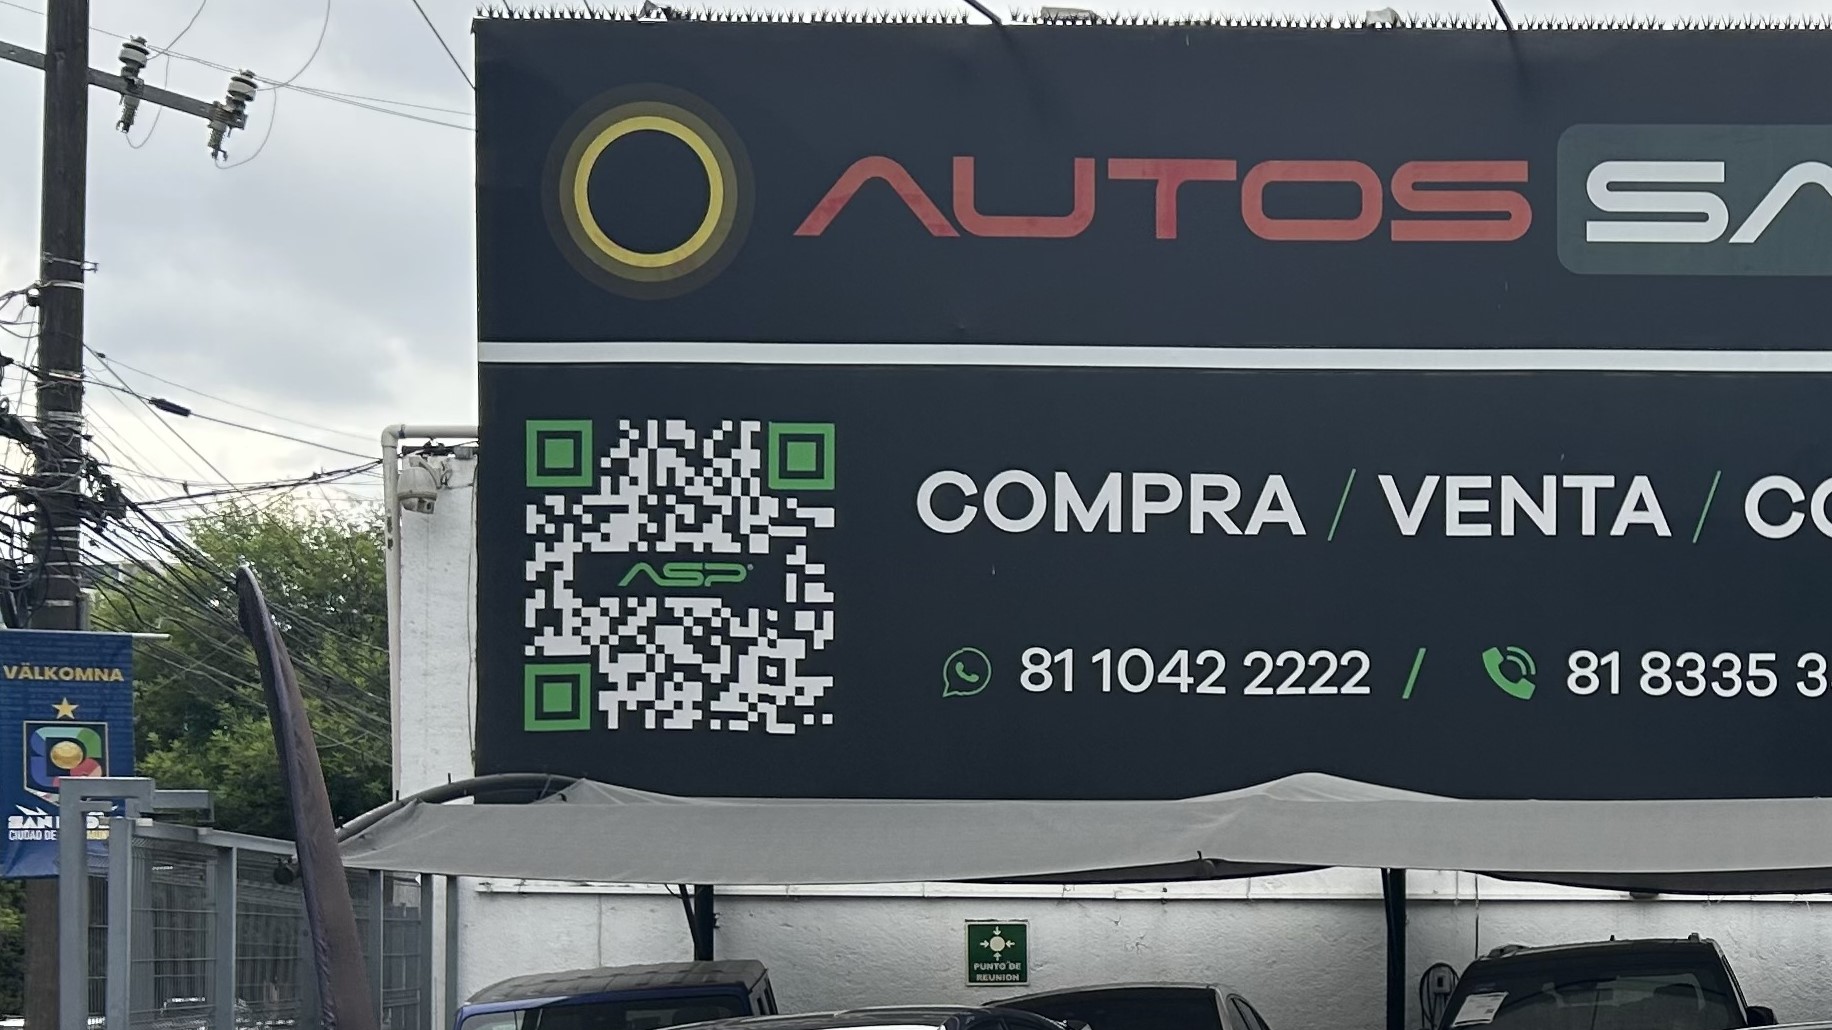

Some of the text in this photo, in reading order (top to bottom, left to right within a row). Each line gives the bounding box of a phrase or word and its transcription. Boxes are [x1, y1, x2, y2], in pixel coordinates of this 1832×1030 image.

[795, 157, 1532, 242] AUTOS
[917, 469, 1306, 536] COMPRA
[1378, 474, 1671, 537] VENTA
[3, 662, 124, 682] VÄLKOMNA
[1019, 647, 1073, 692] 81
[1092, 648, 1227, 694] 1042
[1243, 650, 1370, 695] 2222
[1566, 650, 1619, 695] 81
[1639, 651, 1777, 697] 8335
[8, 829, 57, 841] CIUDAD DE
[973, 962, 1022, 971] PUNTO DE
